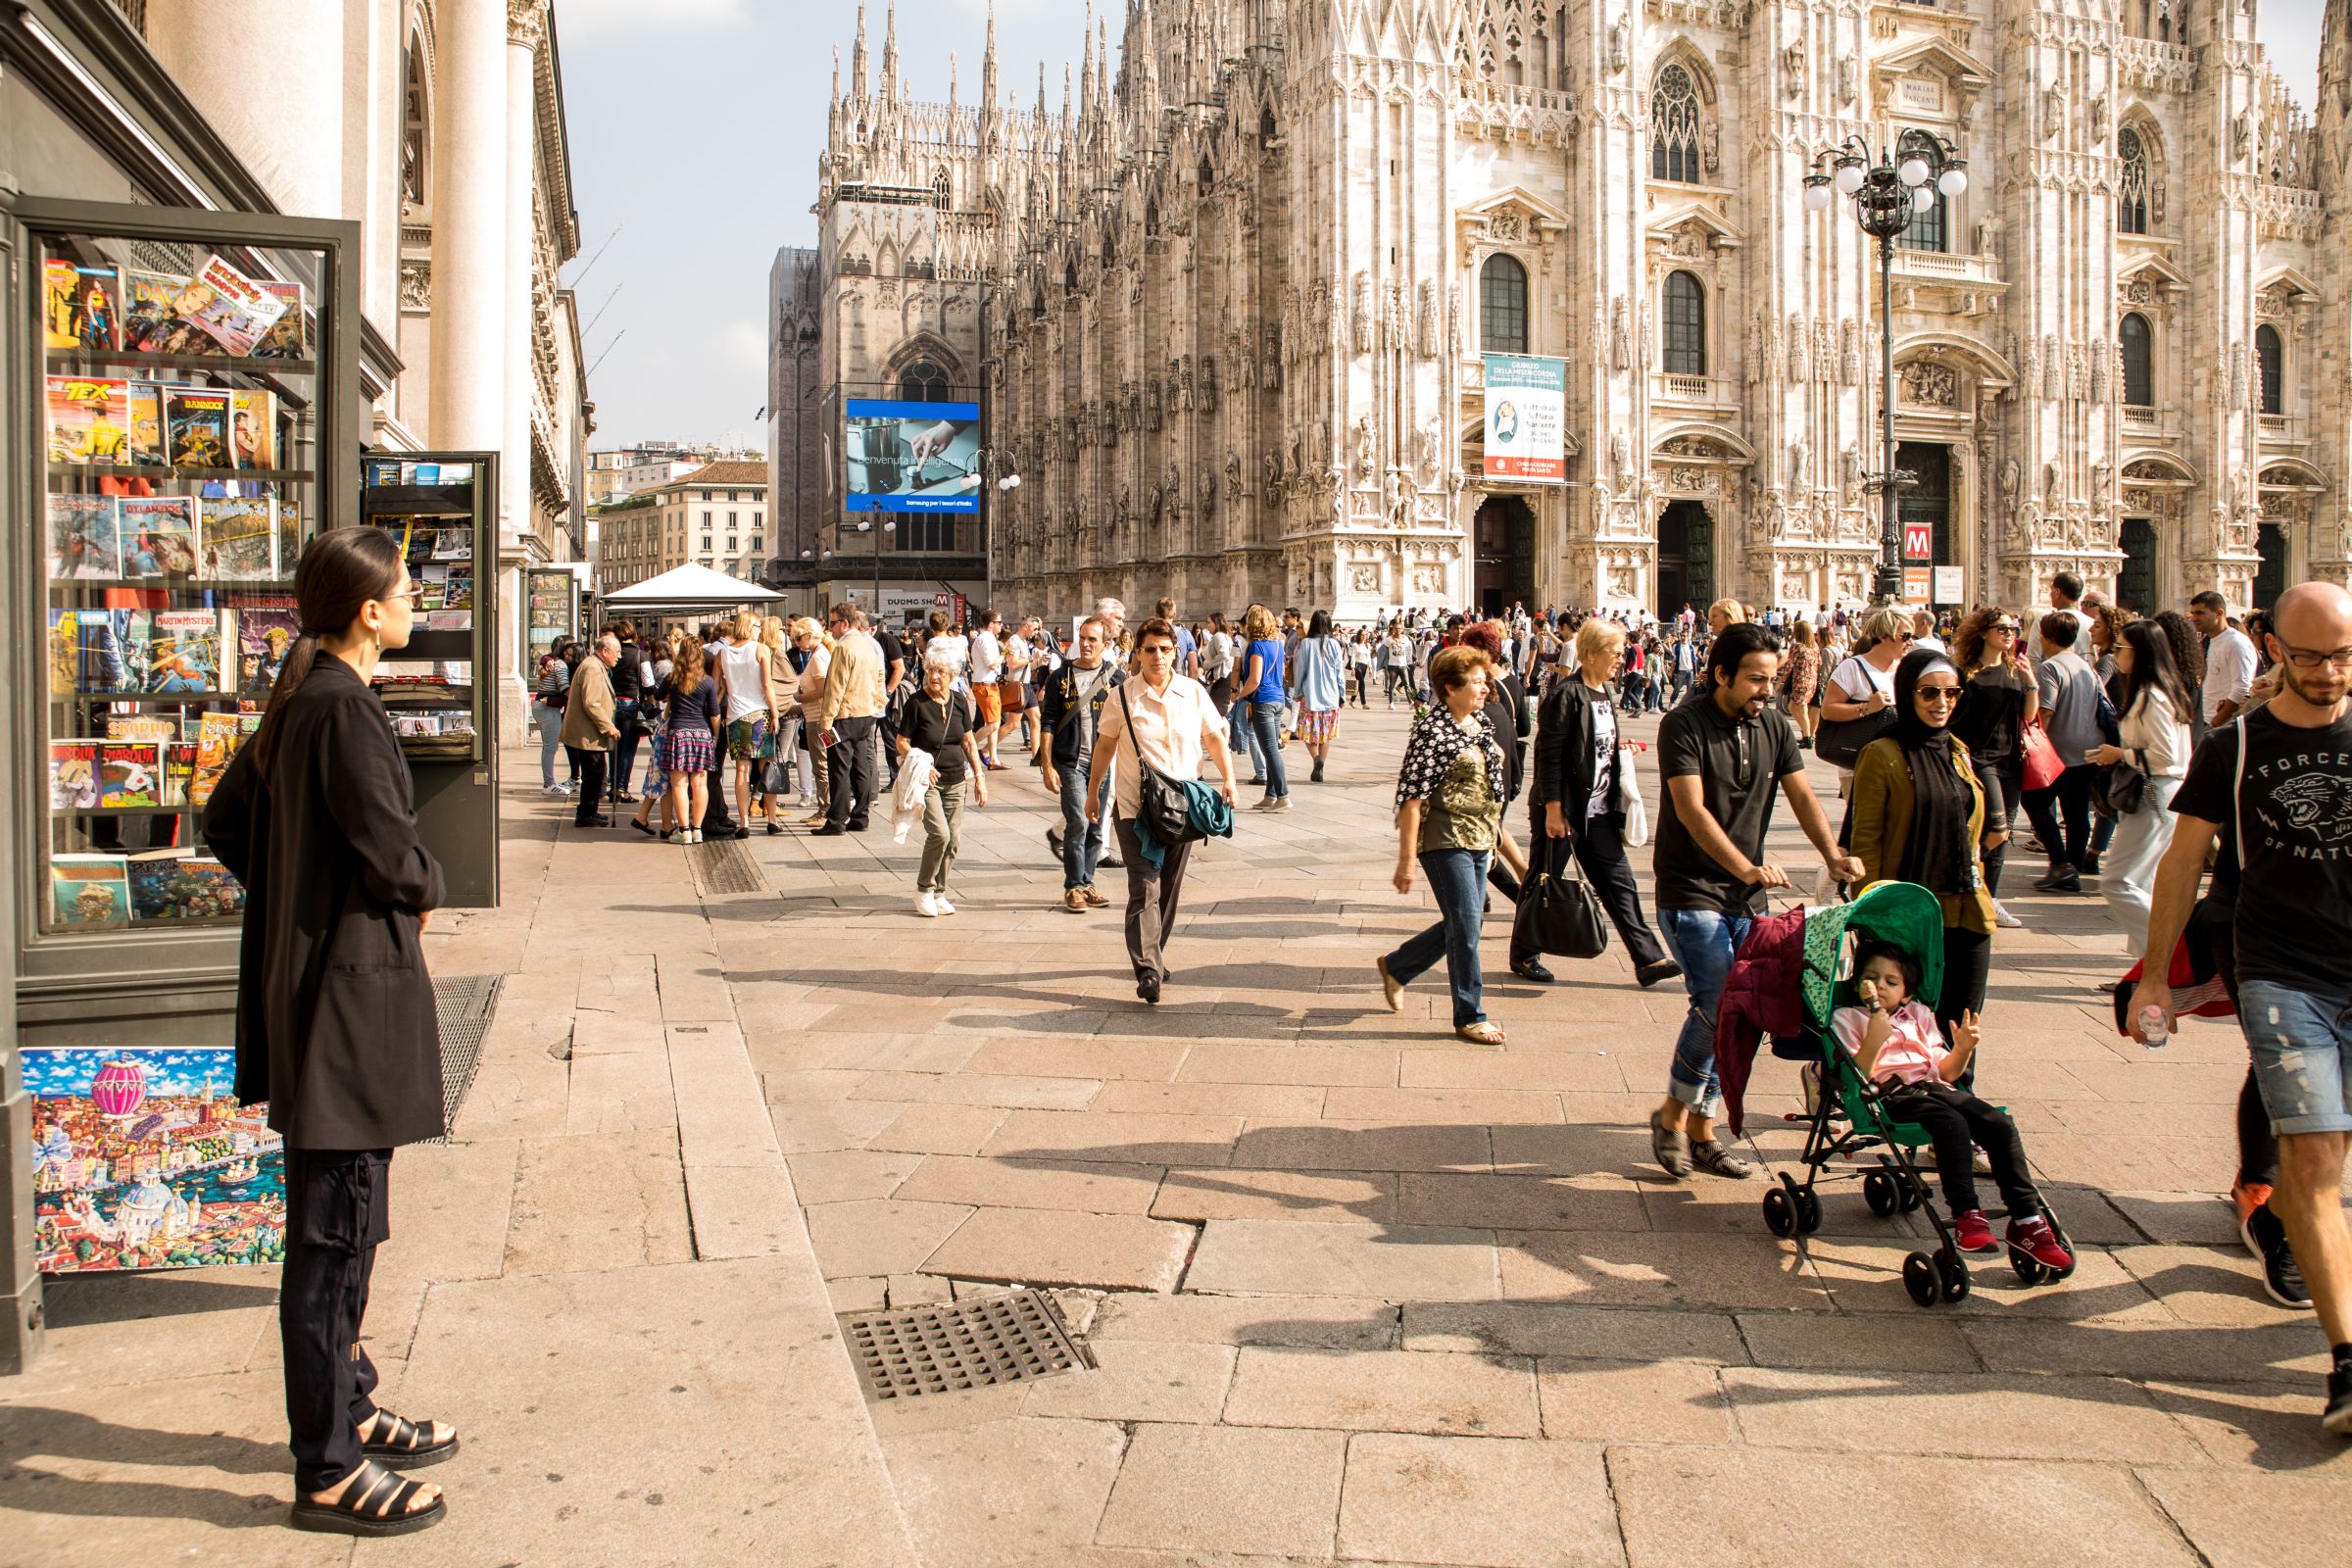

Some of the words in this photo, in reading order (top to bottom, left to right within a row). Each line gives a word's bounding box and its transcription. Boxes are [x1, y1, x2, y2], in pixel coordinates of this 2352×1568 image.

[63, 381, 112, 401] TEX
[184, 400, 224, 410] BANNOCK
[858, 455, 909, 466] Benvenuta
[125, 505, 158, 514] DYLAN
[1906, 531, 1929, 552] M
[936, 595, 948, 605] M
[156, 614, 182, 626] MARTIN
[108, 721, 175, 737] SKORPIO
[103, 748, 156, 763] DIABOLIK
[2258, 752, 2350, 778] FORCE
[2265, 837, 2284, 850] OF
